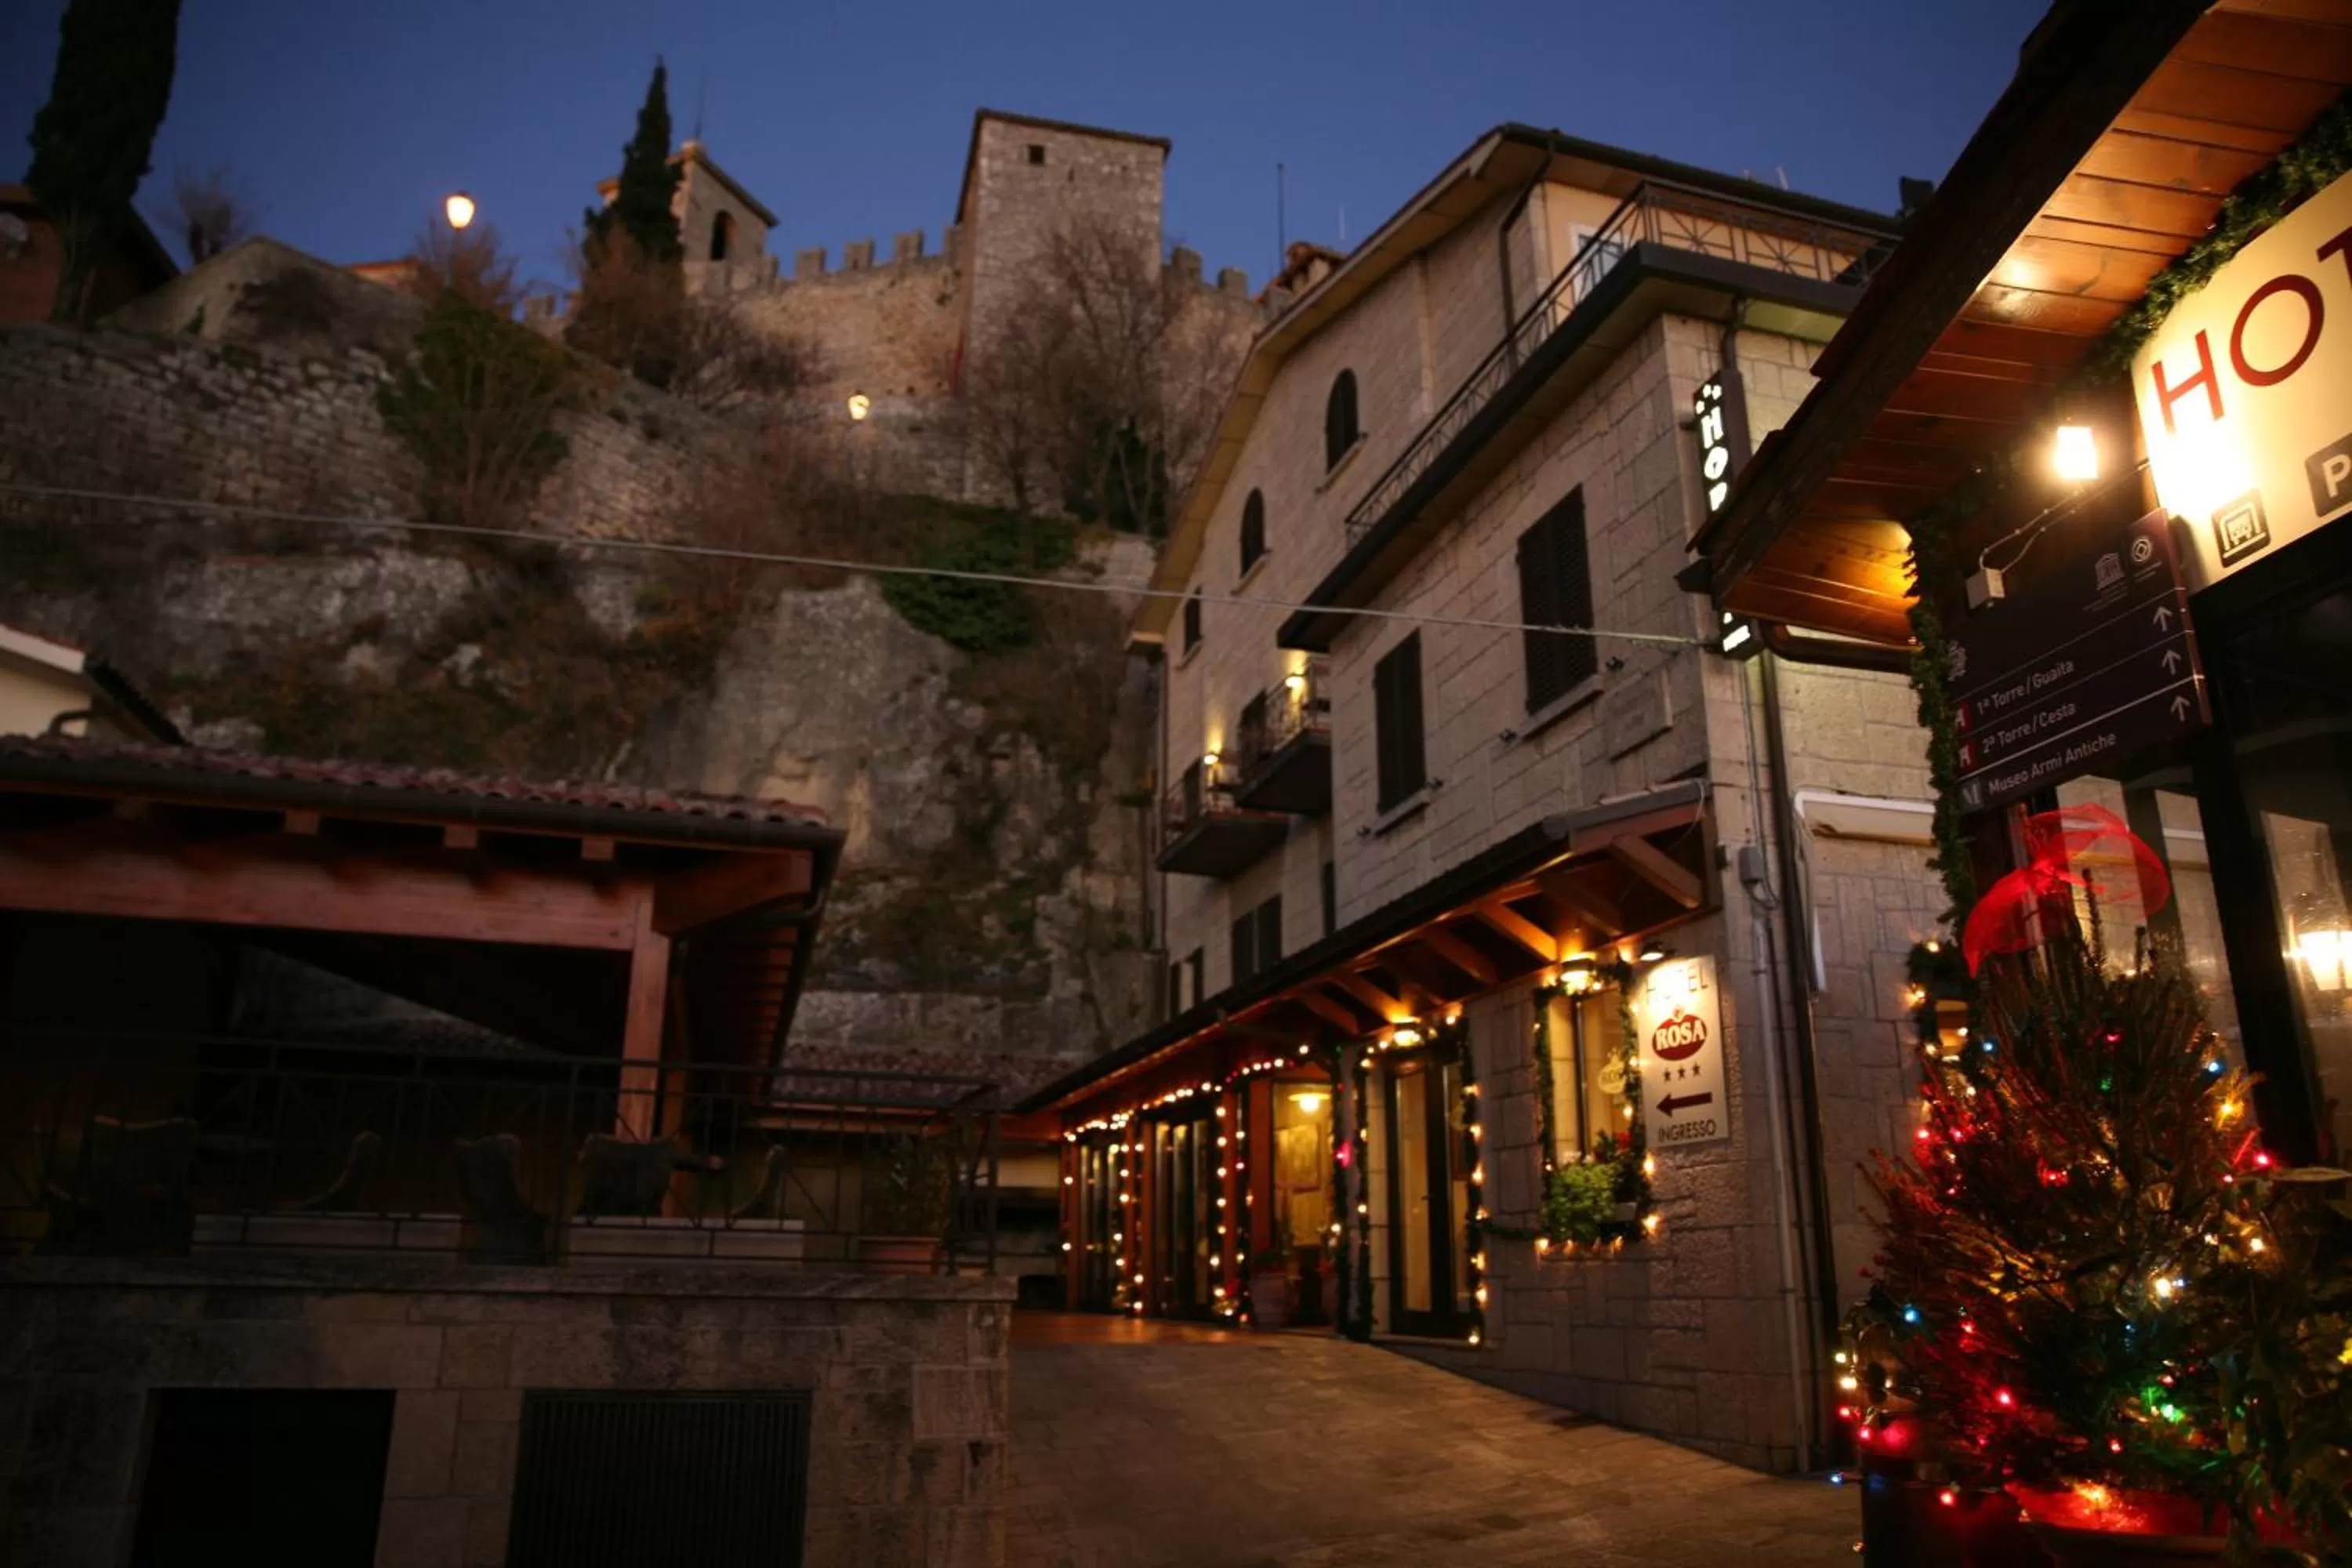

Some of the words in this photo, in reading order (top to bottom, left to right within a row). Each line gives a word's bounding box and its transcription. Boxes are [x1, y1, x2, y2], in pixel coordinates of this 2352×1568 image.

[1987, 769, 2030, 797] Museo
[2031, 752, 2063, 779] Armi
[2064, 732, 2117, 764] Antiche
[1656, 1020, 1705, 1050] ROSA
[1658, 1119, 1717, 1143] INGRESSO
